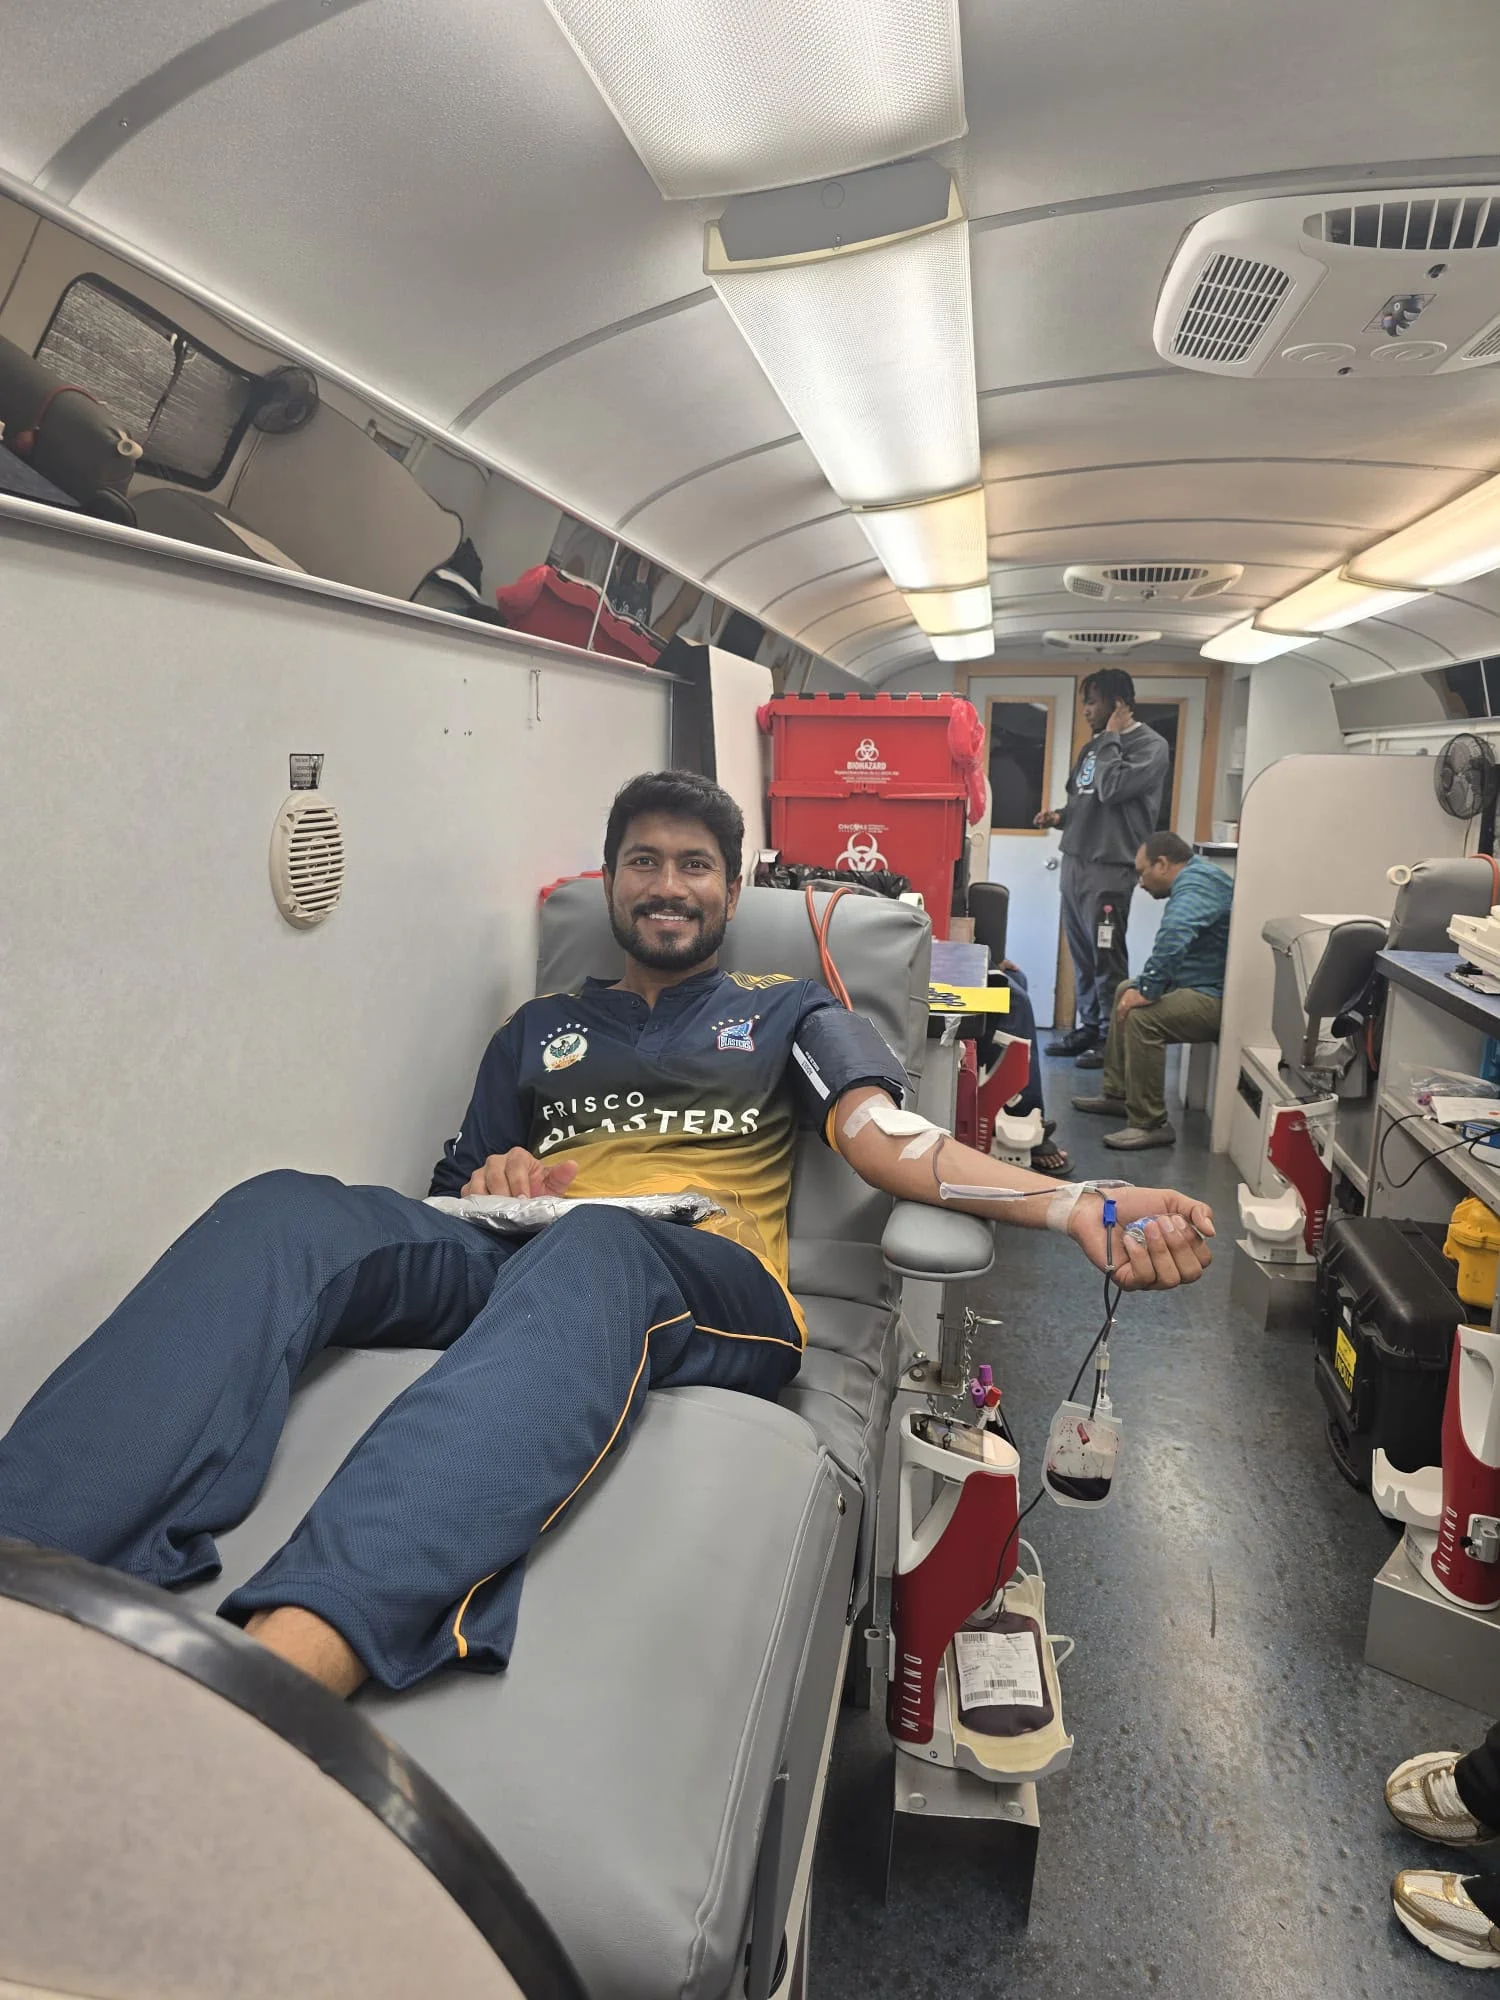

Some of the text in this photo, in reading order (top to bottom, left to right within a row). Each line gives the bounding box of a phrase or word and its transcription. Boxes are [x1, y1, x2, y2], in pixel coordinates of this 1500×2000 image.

[847, 761, 887, 770] BIOHAZARD
[721, 1036, 752, 1050] BLASTERS
[542, 1091, 645, 1121] FRISCO
[1311, 1209, 1325, 1243] ILANO
[1436, 1505, 1458, 1575] MILANO
[901, 1653, 922, 1732] MILANO
